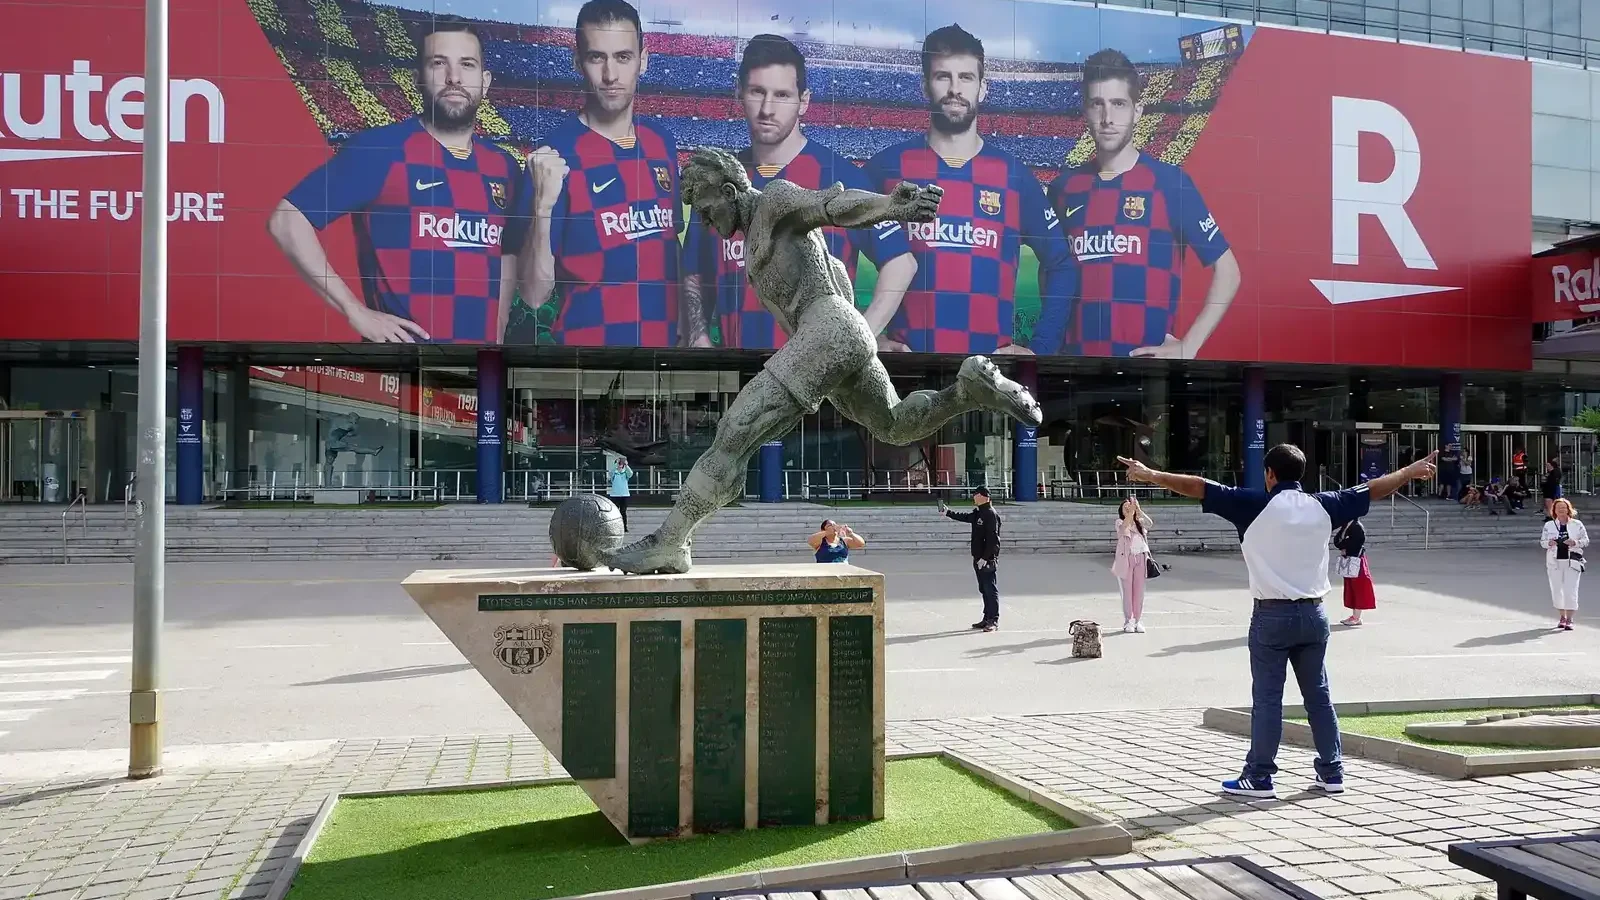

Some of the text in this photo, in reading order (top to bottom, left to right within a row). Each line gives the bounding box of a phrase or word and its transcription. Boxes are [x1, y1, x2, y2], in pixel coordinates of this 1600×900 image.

[0, 60, 225, 143] uten
[1332, 95, 1439, 270] R
[10, 188, 225, 222] THE FUURE
[907, 217, 998, 249] Rakuten
[567, 597, 588, 606] HAN
[624, 595, 679, 605] POSBLES
